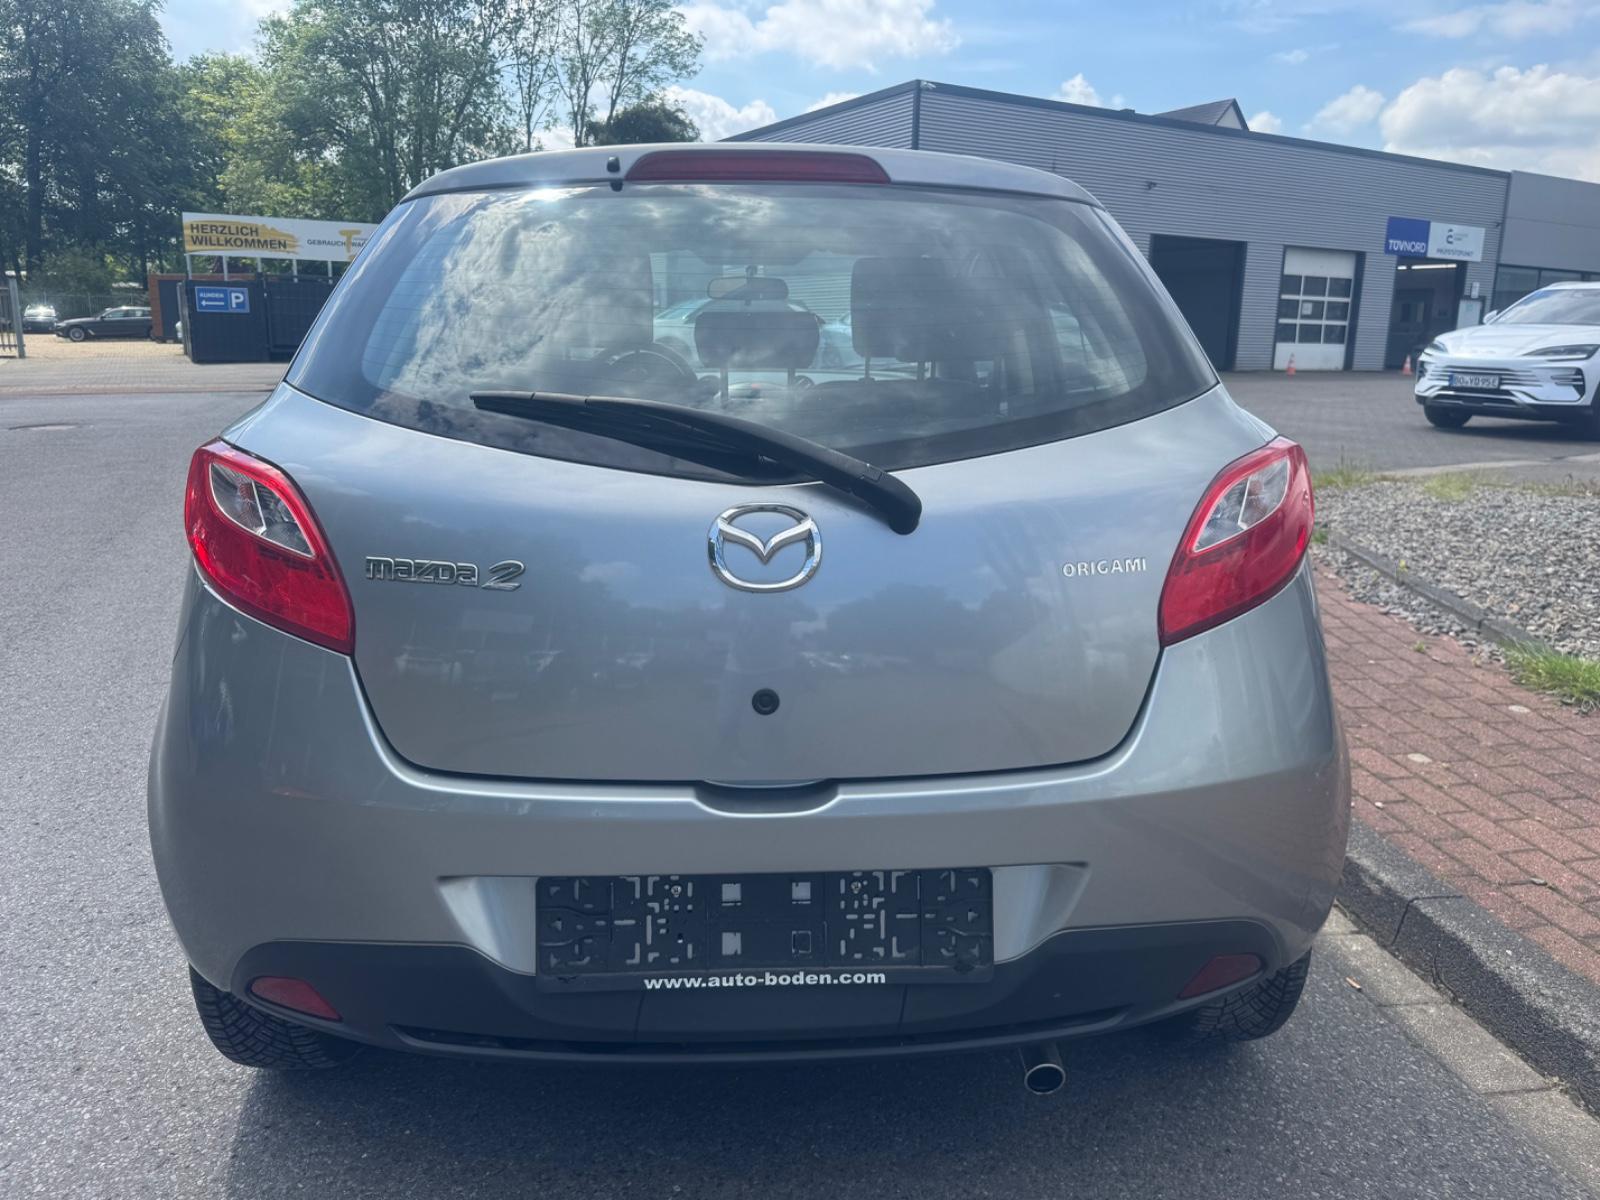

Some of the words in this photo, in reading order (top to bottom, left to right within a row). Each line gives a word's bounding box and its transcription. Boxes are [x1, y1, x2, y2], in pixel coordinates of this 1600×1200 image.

[190, 223, 259, 237] HERZLICH
[190, 235, 288, 250] WILLKOMMEN
[231, 292, 244, 308] P
[481, 559, 526, 592] 2
[1063, 558, 1147, 577] ORIGAMI
[643, 971, 886, 989] www.auto-boden.com
